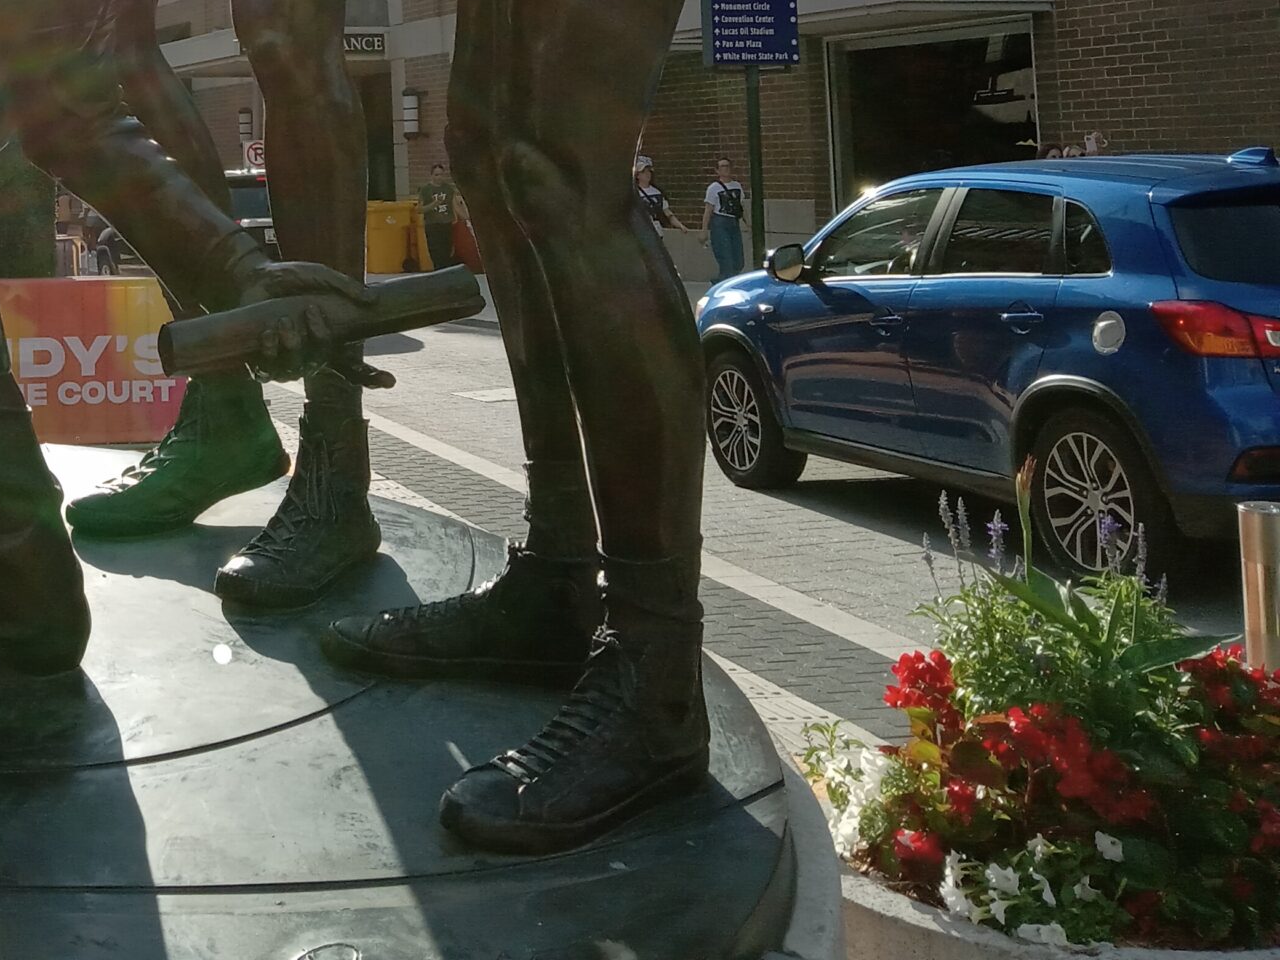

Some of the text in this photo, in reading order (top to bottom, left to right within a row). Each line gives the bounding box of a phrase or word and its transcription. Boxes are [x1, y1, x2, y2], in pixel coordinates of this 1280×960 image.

[721, 2, 770, 11] Monument Circle
[721, 15, 775, 23] Convention Center
[721, 27, 775, 35] Lucas Oil Stadium
[722, 40, 762, 48] Pan Am Plaza
[722, 52, 788, 60] White River State Park
[57, 379, 176, 405] COURT
